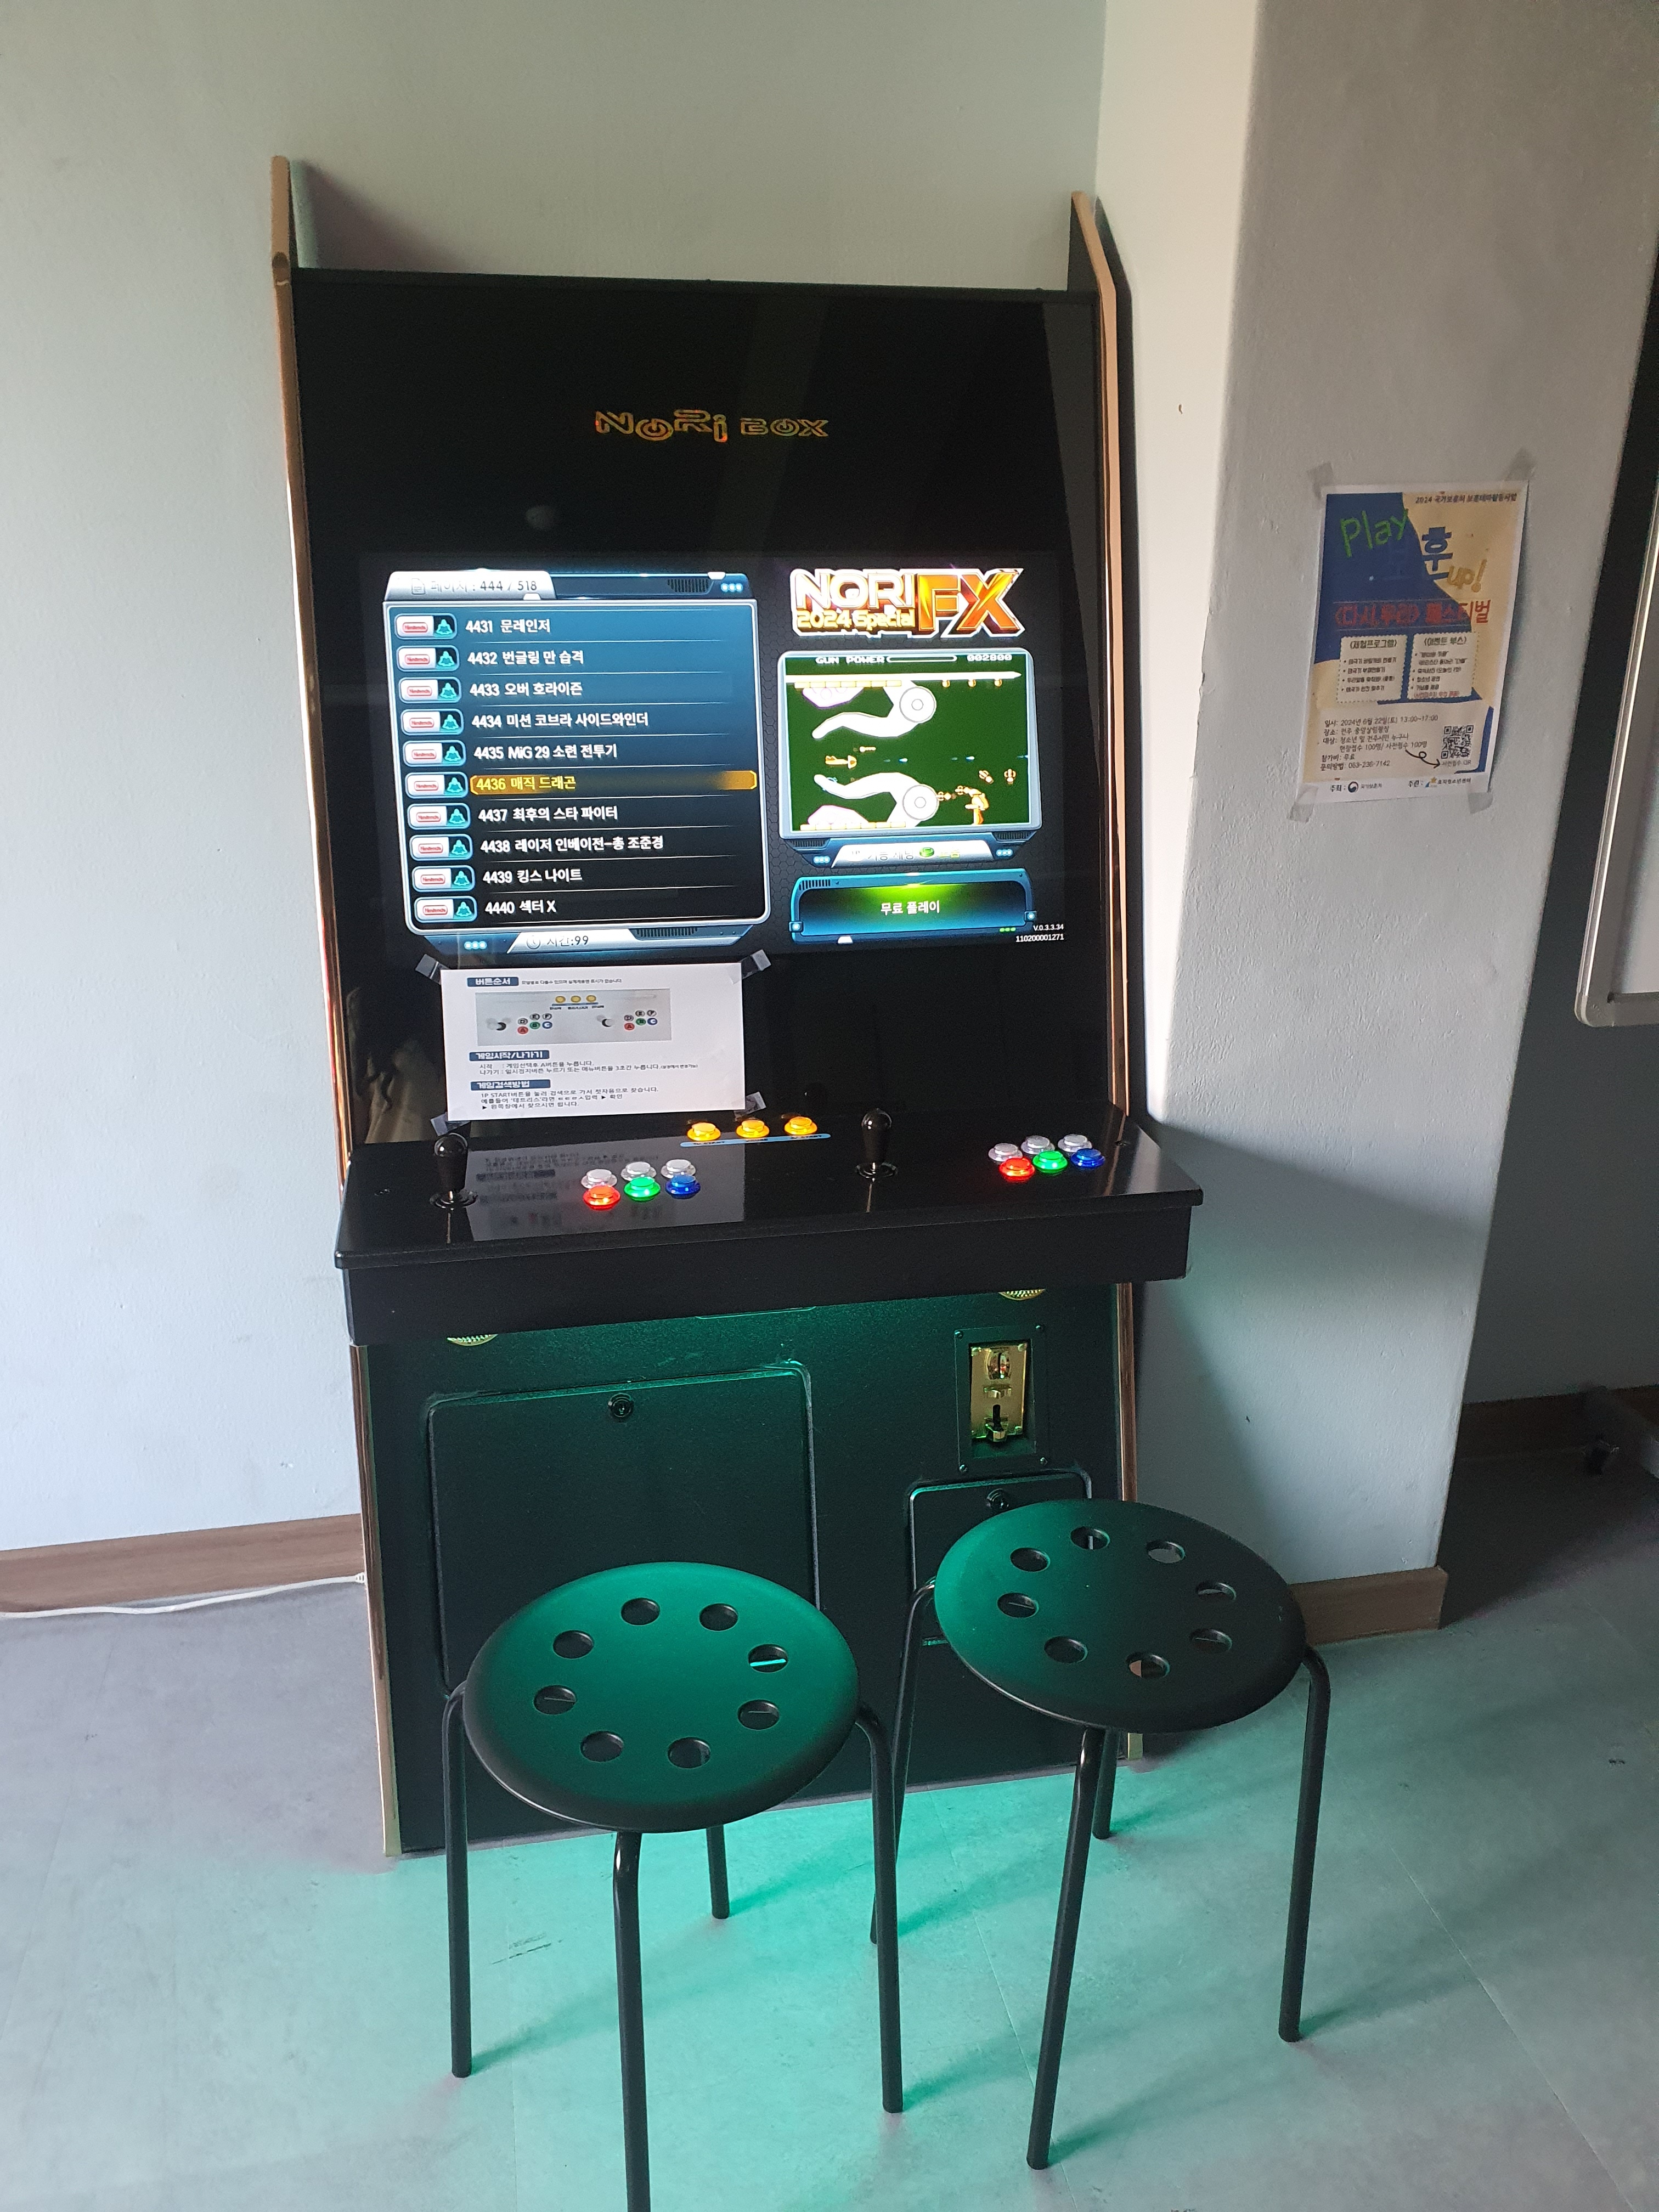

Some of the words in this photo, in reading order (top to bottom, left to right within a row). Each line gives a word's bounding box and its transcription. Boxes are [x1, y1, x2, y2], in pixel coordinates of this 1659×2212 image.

[741, 418, 829, 436] BOX
[1340, 506, 1409, 558] Play
[1446, 559, 1487, 593] up!
[479, 580, 503, 591] 444
[517, 580, 537, 591] 518
[793, 572, 916, 610] NORI
[917, 571, 1022, 633] FX
[465, 619, 493, 634] 4431
[500, 619, 551, 634] 문레인저
[796, 608, 853, 629] 2024
[853, 608, 916, 633] Special
[467, 651, 498, 665] 4432
[502, 650, 540, 665] 번글링
[543, 650, 556, 664] 만
[558, 650, 584, 665] 습격
[815, 656, 839, 665] GUN
[845, 655, 885, 664] POWER
[469, 683, 500, 697] 4433
[504, 682, 529, 697] 오버
[532, 681, 583, 697] 호라이즌
[471, 715, 502, 729] 4434
[506, 714, 531, 728] 미션
[534, 713, 572, 728] 코브라
[575, 712, 648, 727] 사이드와인더
[1340, 718, 1361, 726] 2024년
[473, 746, 504, 760] 4435
[535, 745, 550, 759] 29
[552, 745, 577, 759] 소련
[580, 743, 617, 759] 전투기
[476, 777, 506, 791] 4436
[510, 776, 535, 791] 매직
[539, 776, 576, 790] 드래곤
[478, 808, 508, 821] 4437
[512, 806, 550, 821] 최후의
[553, 806, 578, 820] 스타
[581, 805, 618, 820] 파이터
[480, 839, 511, 853] 4438
[514, 838, 551, 853] 레이저
[555, 836, 624, 851] 인베이전-총
[628, 835, 663, 850] 조준경
[482, 870, 513, 884] 4439
[516, 869, 542, 883] 킹스
[545, 868, 583, 882] 나이트
[485, 901, 515, 915] 4440
[518, 900, 544, 915] 섹터
[546, 900, 557, 913] X
[880, 902, 904, 915] 무료
[906, 899, 940, 915] 플레이
[1032, 923, 1064, 932] V.0.3.3.34
[1015, 933, 1065, 943] 110200001271
[475, 977, 511, 985] 버튼순서
[476, 1051, 543, 1059] 게임시작/나가기
[477, 1081, 530, 1089] 게임검색방법
